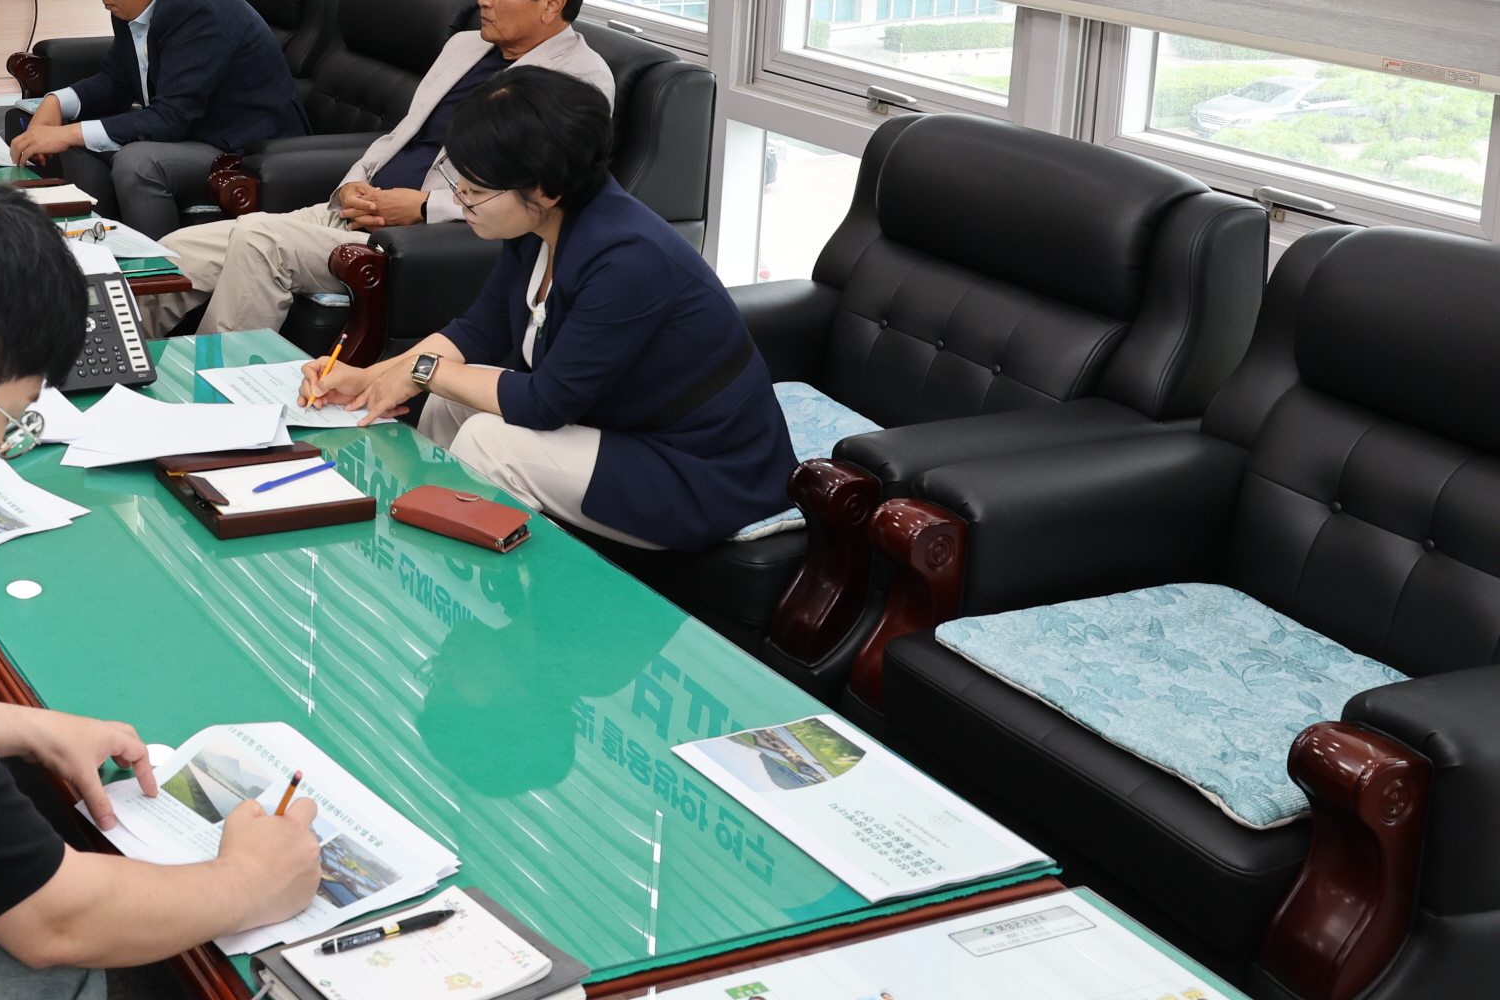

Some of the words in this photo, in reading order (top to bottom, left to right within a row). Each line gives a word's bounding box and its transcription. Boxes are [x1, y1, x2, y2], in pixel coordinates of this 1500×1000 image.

[255, 744, 282, 769] 주민주도
[281, 765, 315, 795] 마을동체
[313, 792, 355, 826] 신재생에너지
